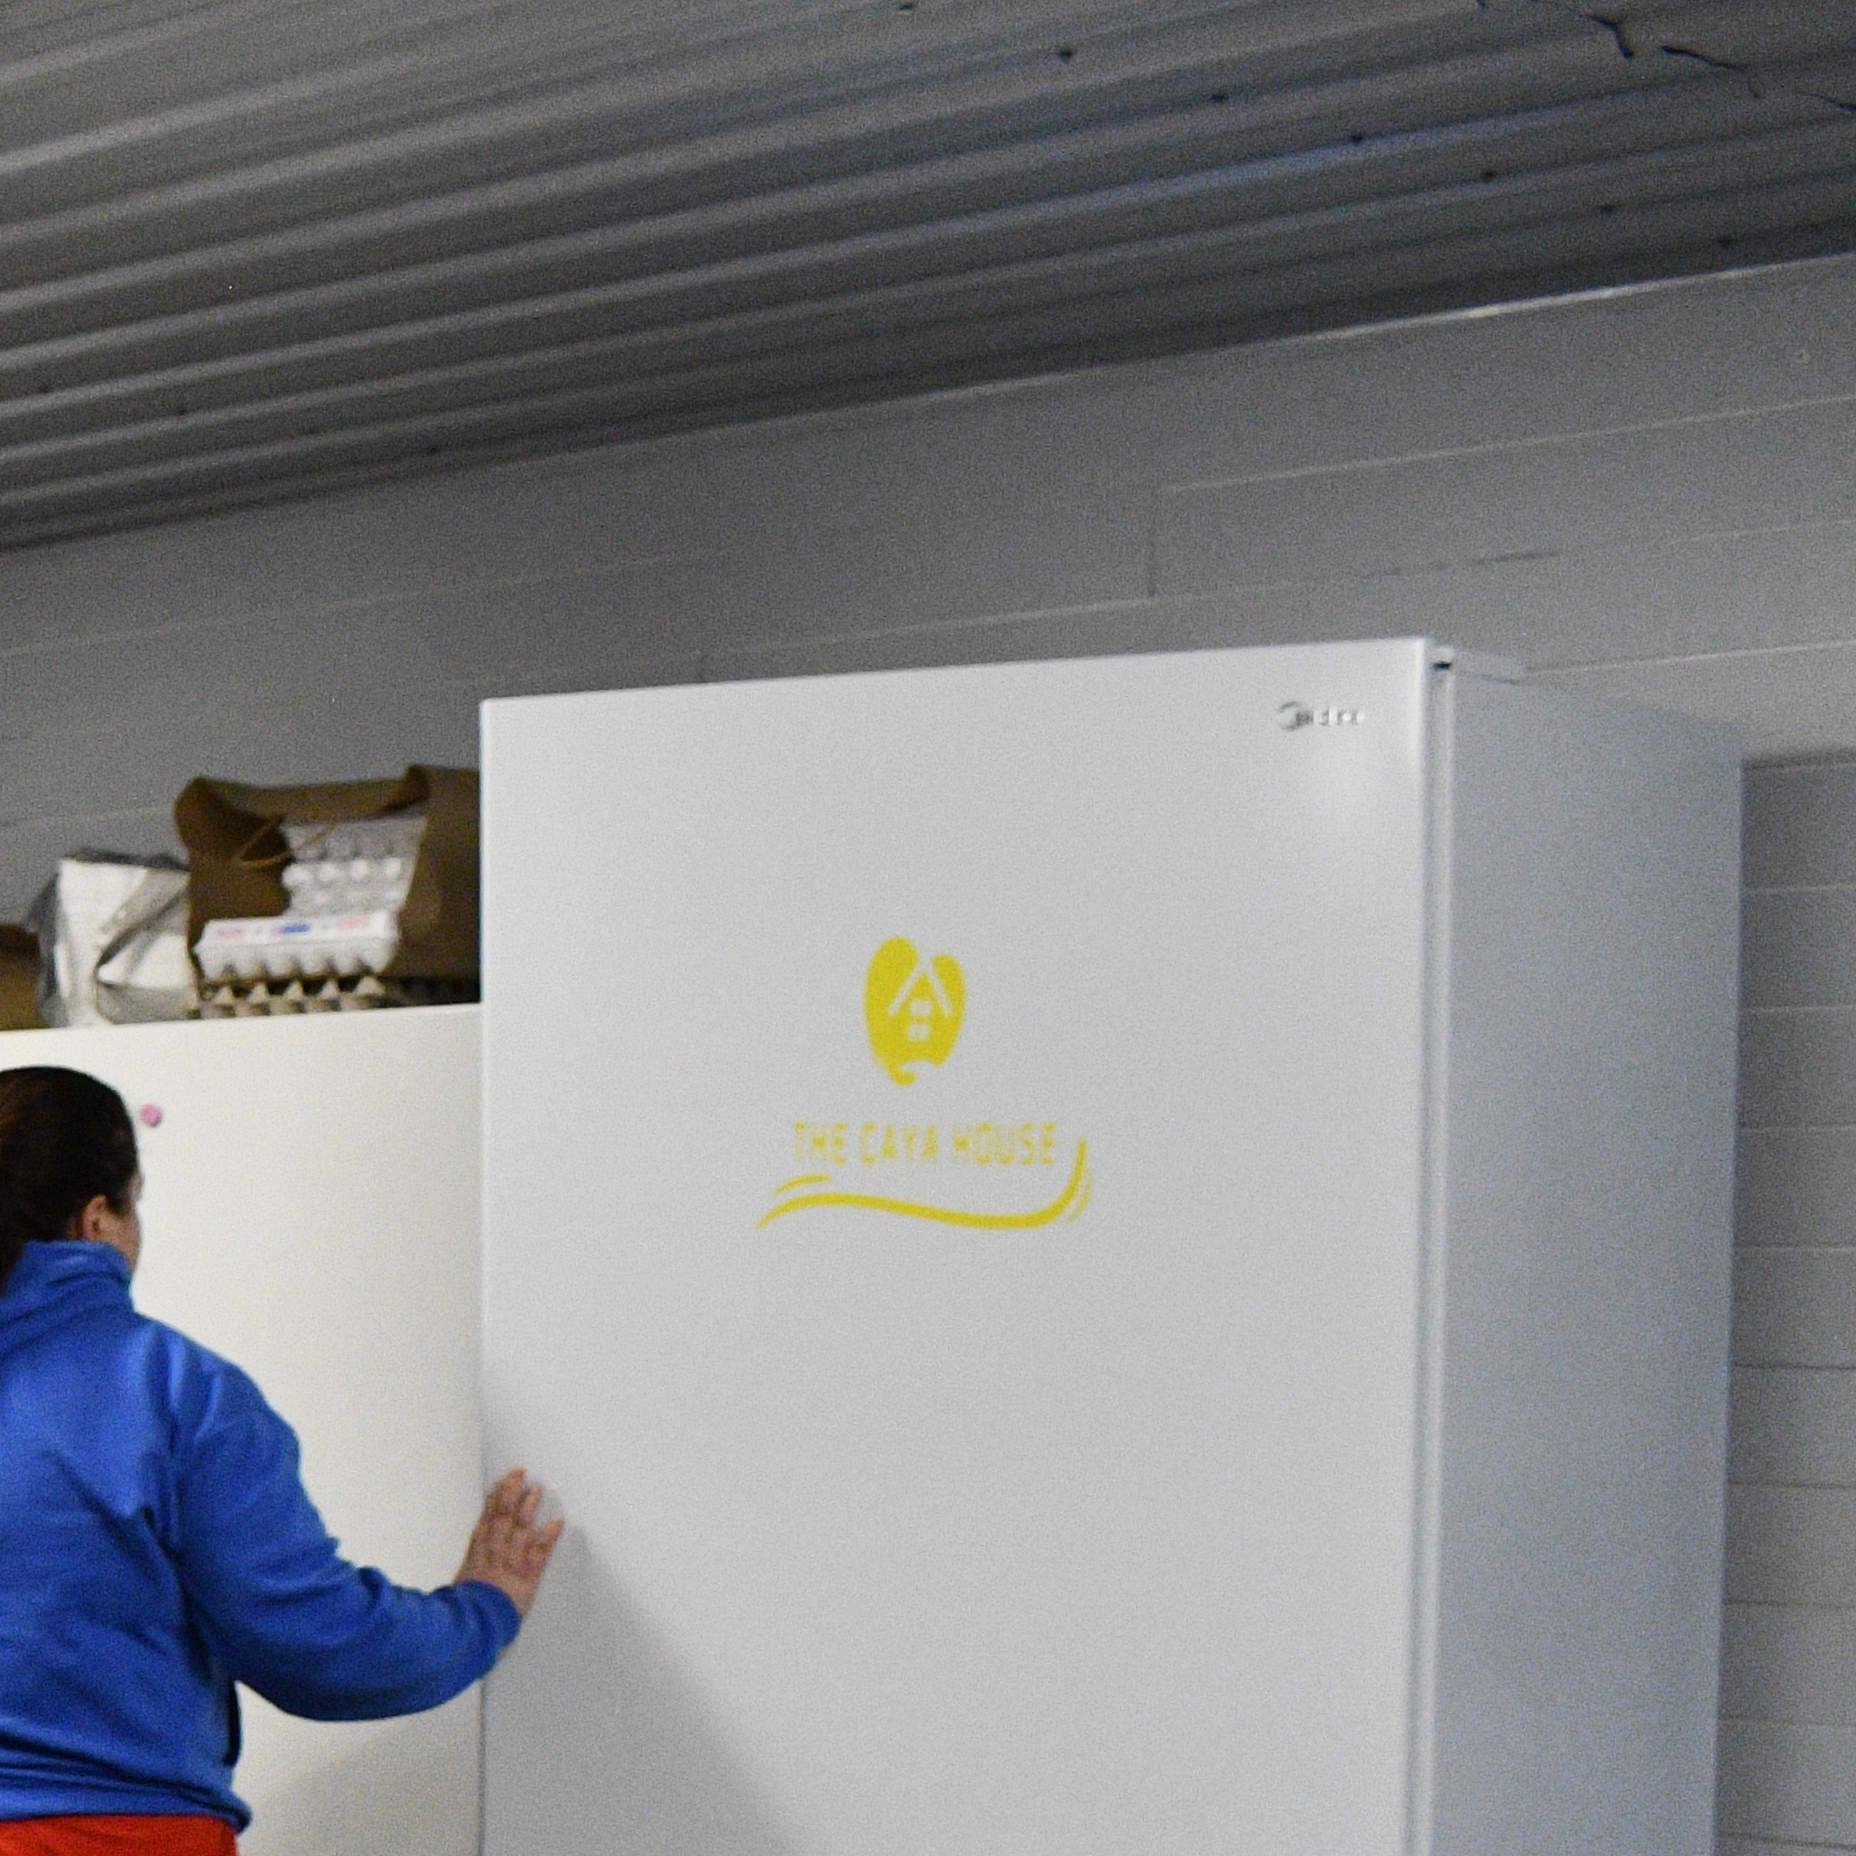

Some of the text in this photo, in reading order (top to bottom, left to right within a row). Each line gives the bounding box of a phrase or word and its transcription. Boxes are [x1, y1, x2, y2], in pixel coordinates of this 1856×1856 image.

[794, 1121, 1057, 1165] THE CAYA HOUSE
